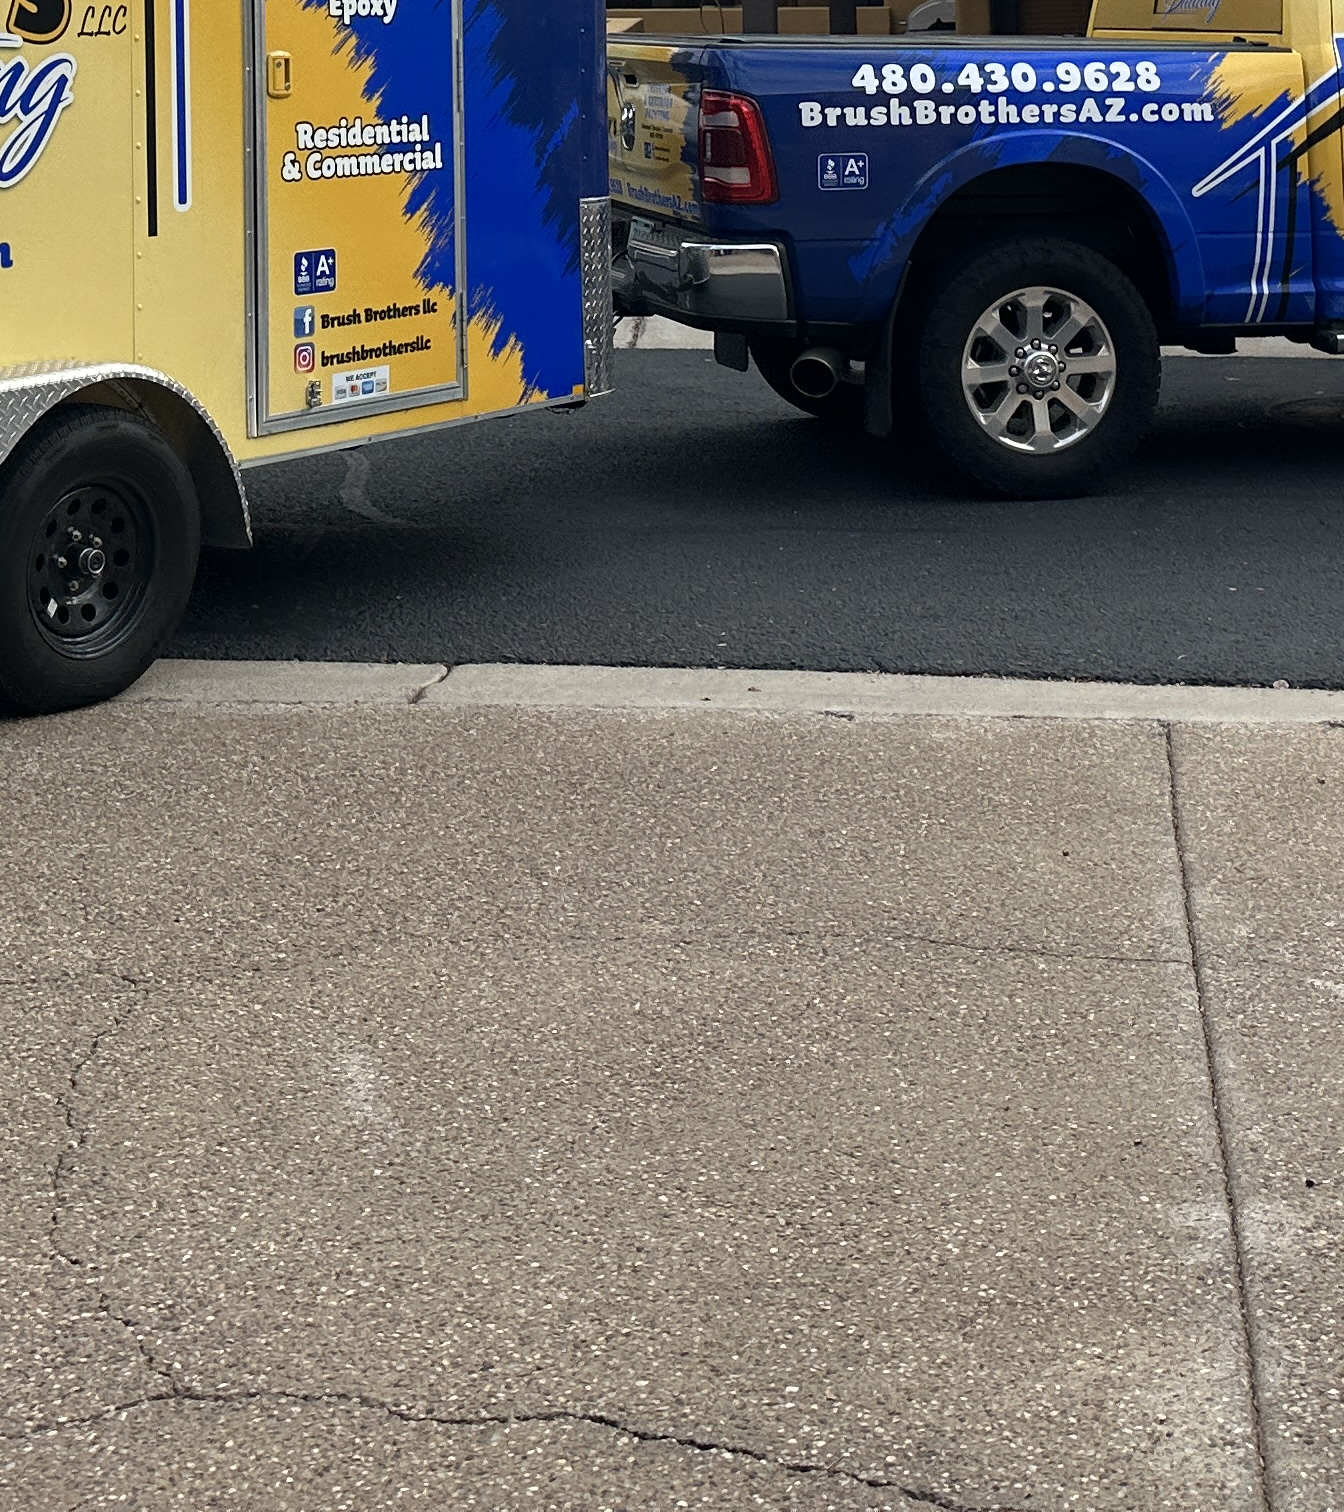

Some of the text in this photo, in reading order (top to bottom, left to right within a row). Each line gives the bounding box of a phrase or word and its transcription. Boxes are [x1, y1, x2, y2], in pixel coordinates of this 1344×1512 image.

[76, 3, 129, 37] LLC
[851, 61, 1161, 94] 480.430.9628
[798, 96, 1215, 128] BrushBrothersAZ.com
[294, 113, 431, 151] Residential
[281, 141, 444, 182] & Commercial
[320, 308, 362, 329] Brush
[364, 302, 421, 322] Brothers
[422, 298, 438, 315] llc
[320, 335, 432, 367] brushbrothersllc
